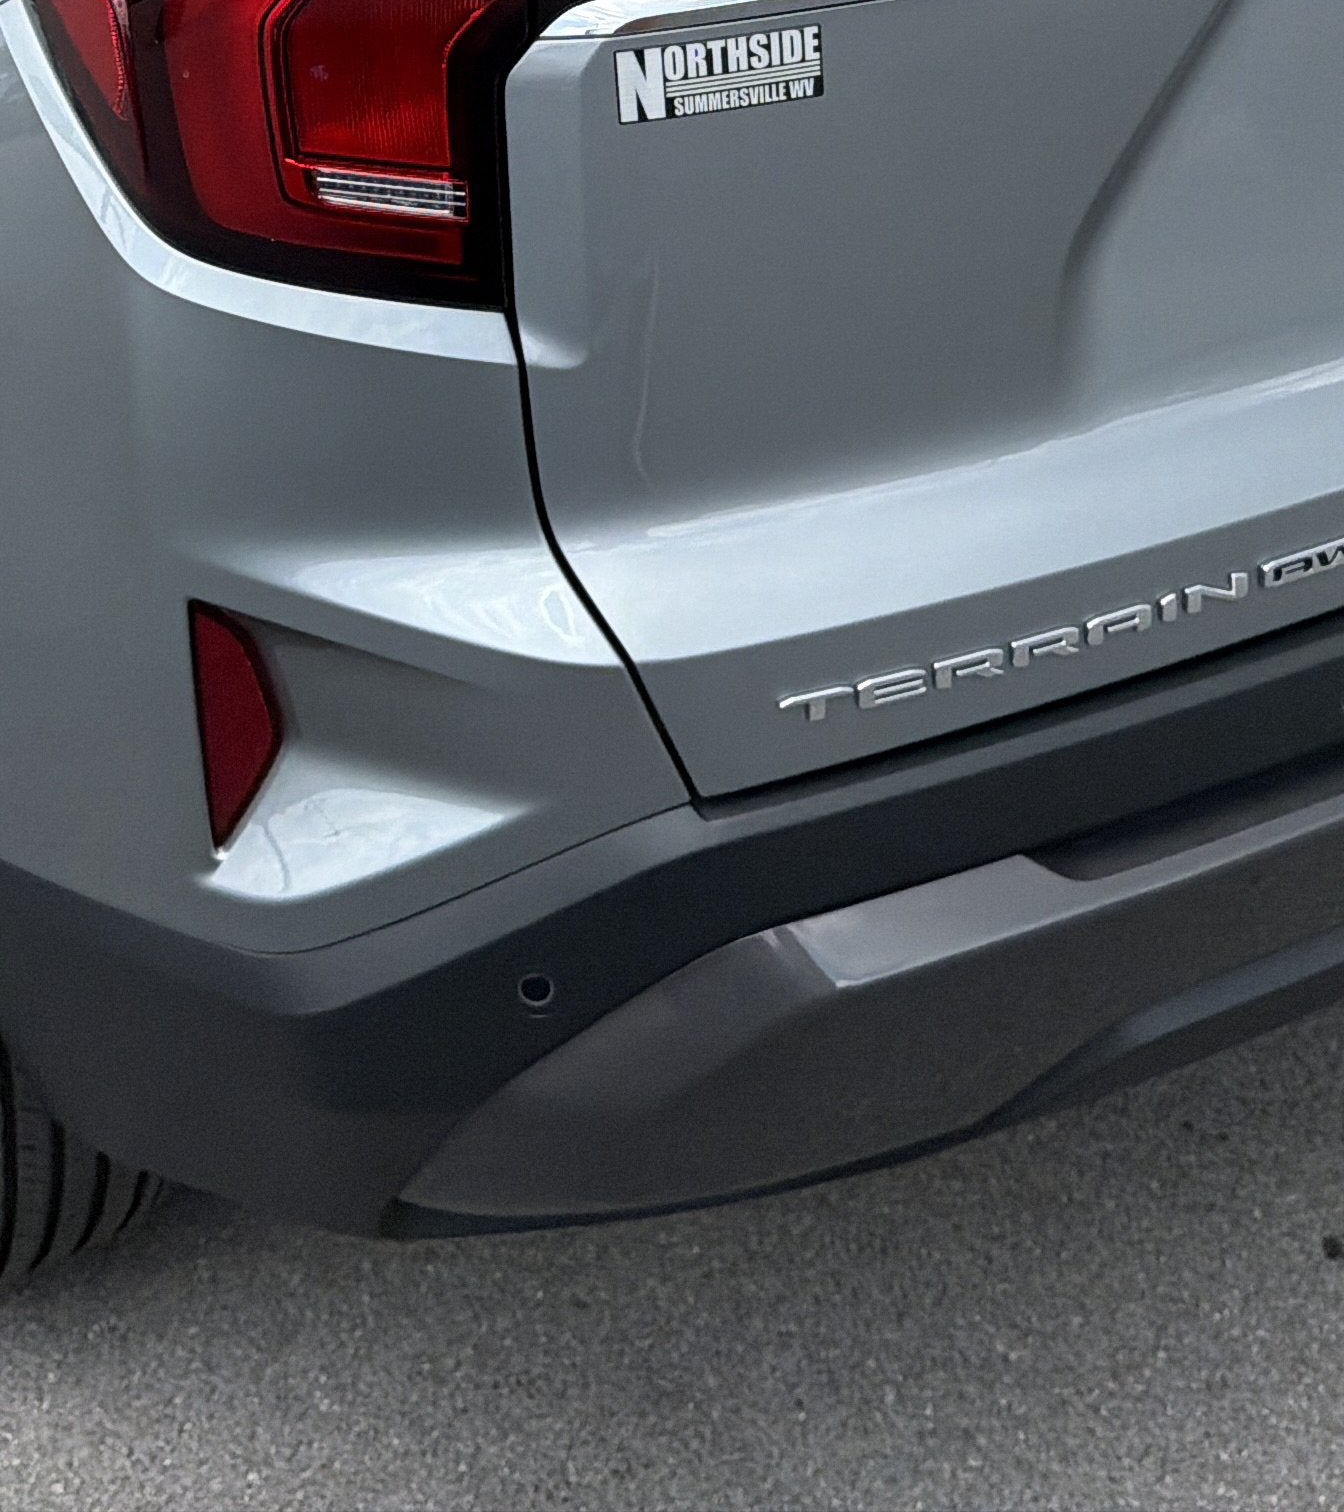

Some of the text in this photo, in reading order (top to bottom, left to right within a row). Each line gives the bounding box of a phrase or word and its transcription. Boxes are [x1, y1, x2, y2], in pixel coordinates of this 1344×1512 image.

[615, 25, 822, 124] NORTHSIDE
[674, 78, 815, 116] SUMMERSVILLE WV
[777, 571, 1250, 721] TERRAIN
